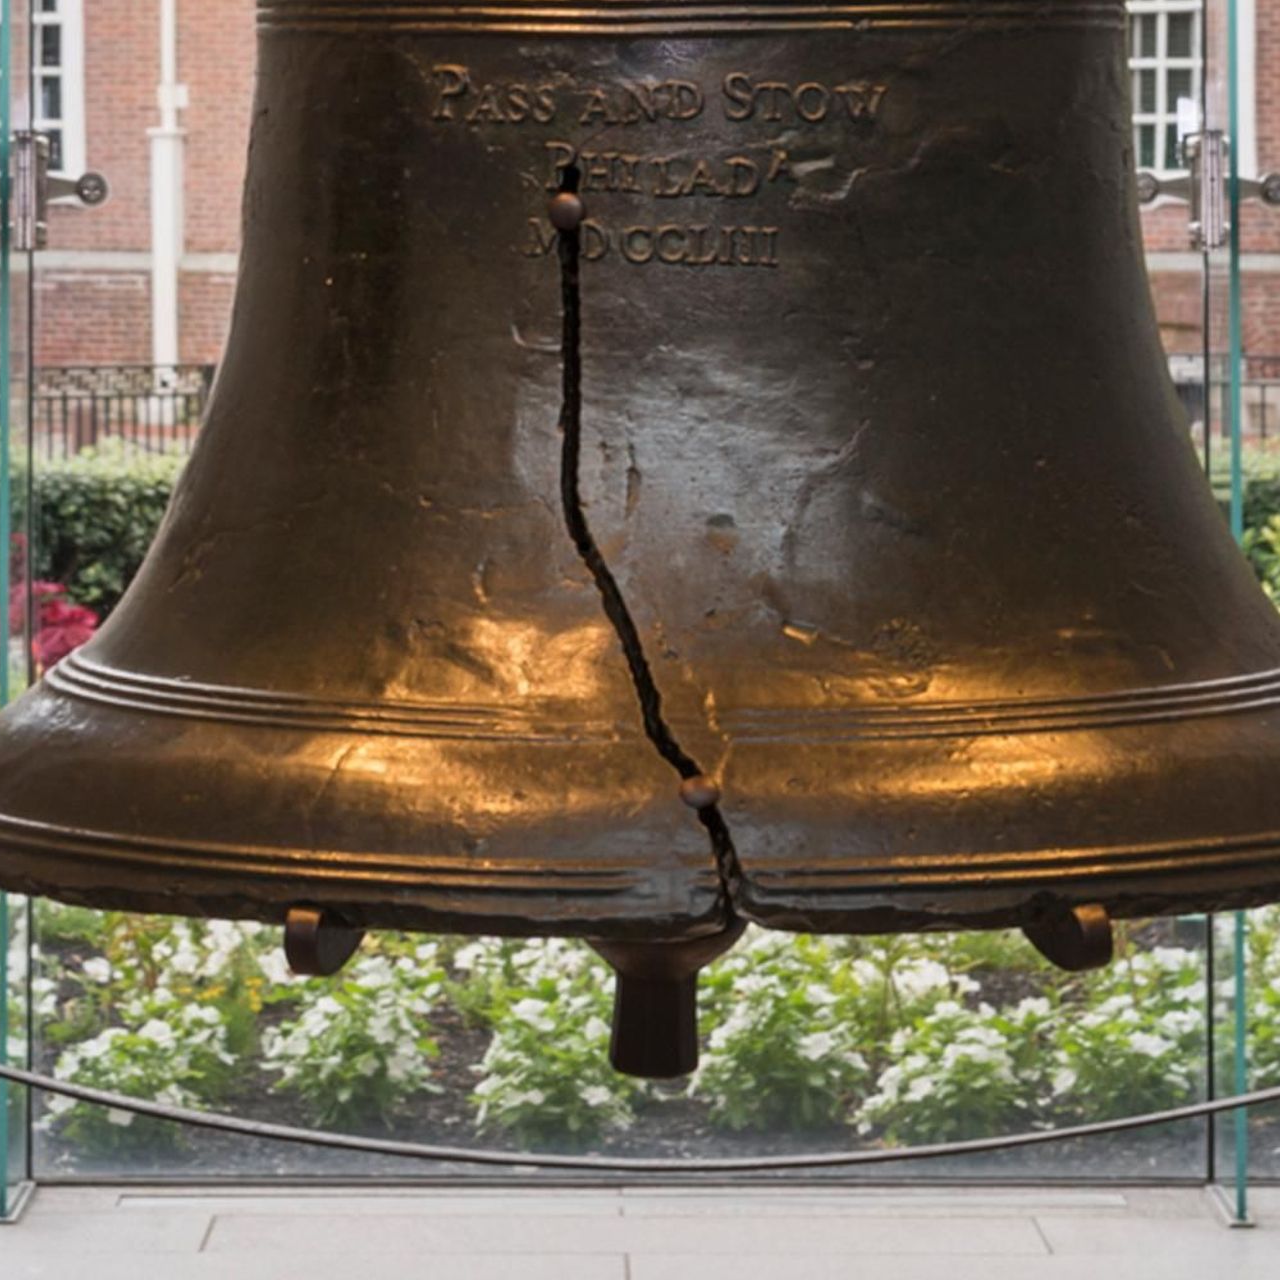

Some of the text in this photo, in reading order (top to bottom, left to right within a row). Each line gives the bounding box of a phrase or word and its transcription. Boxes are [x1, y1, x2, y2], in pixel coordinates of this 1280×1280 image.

[431, 63, 888, 124] PASS AND STOW
